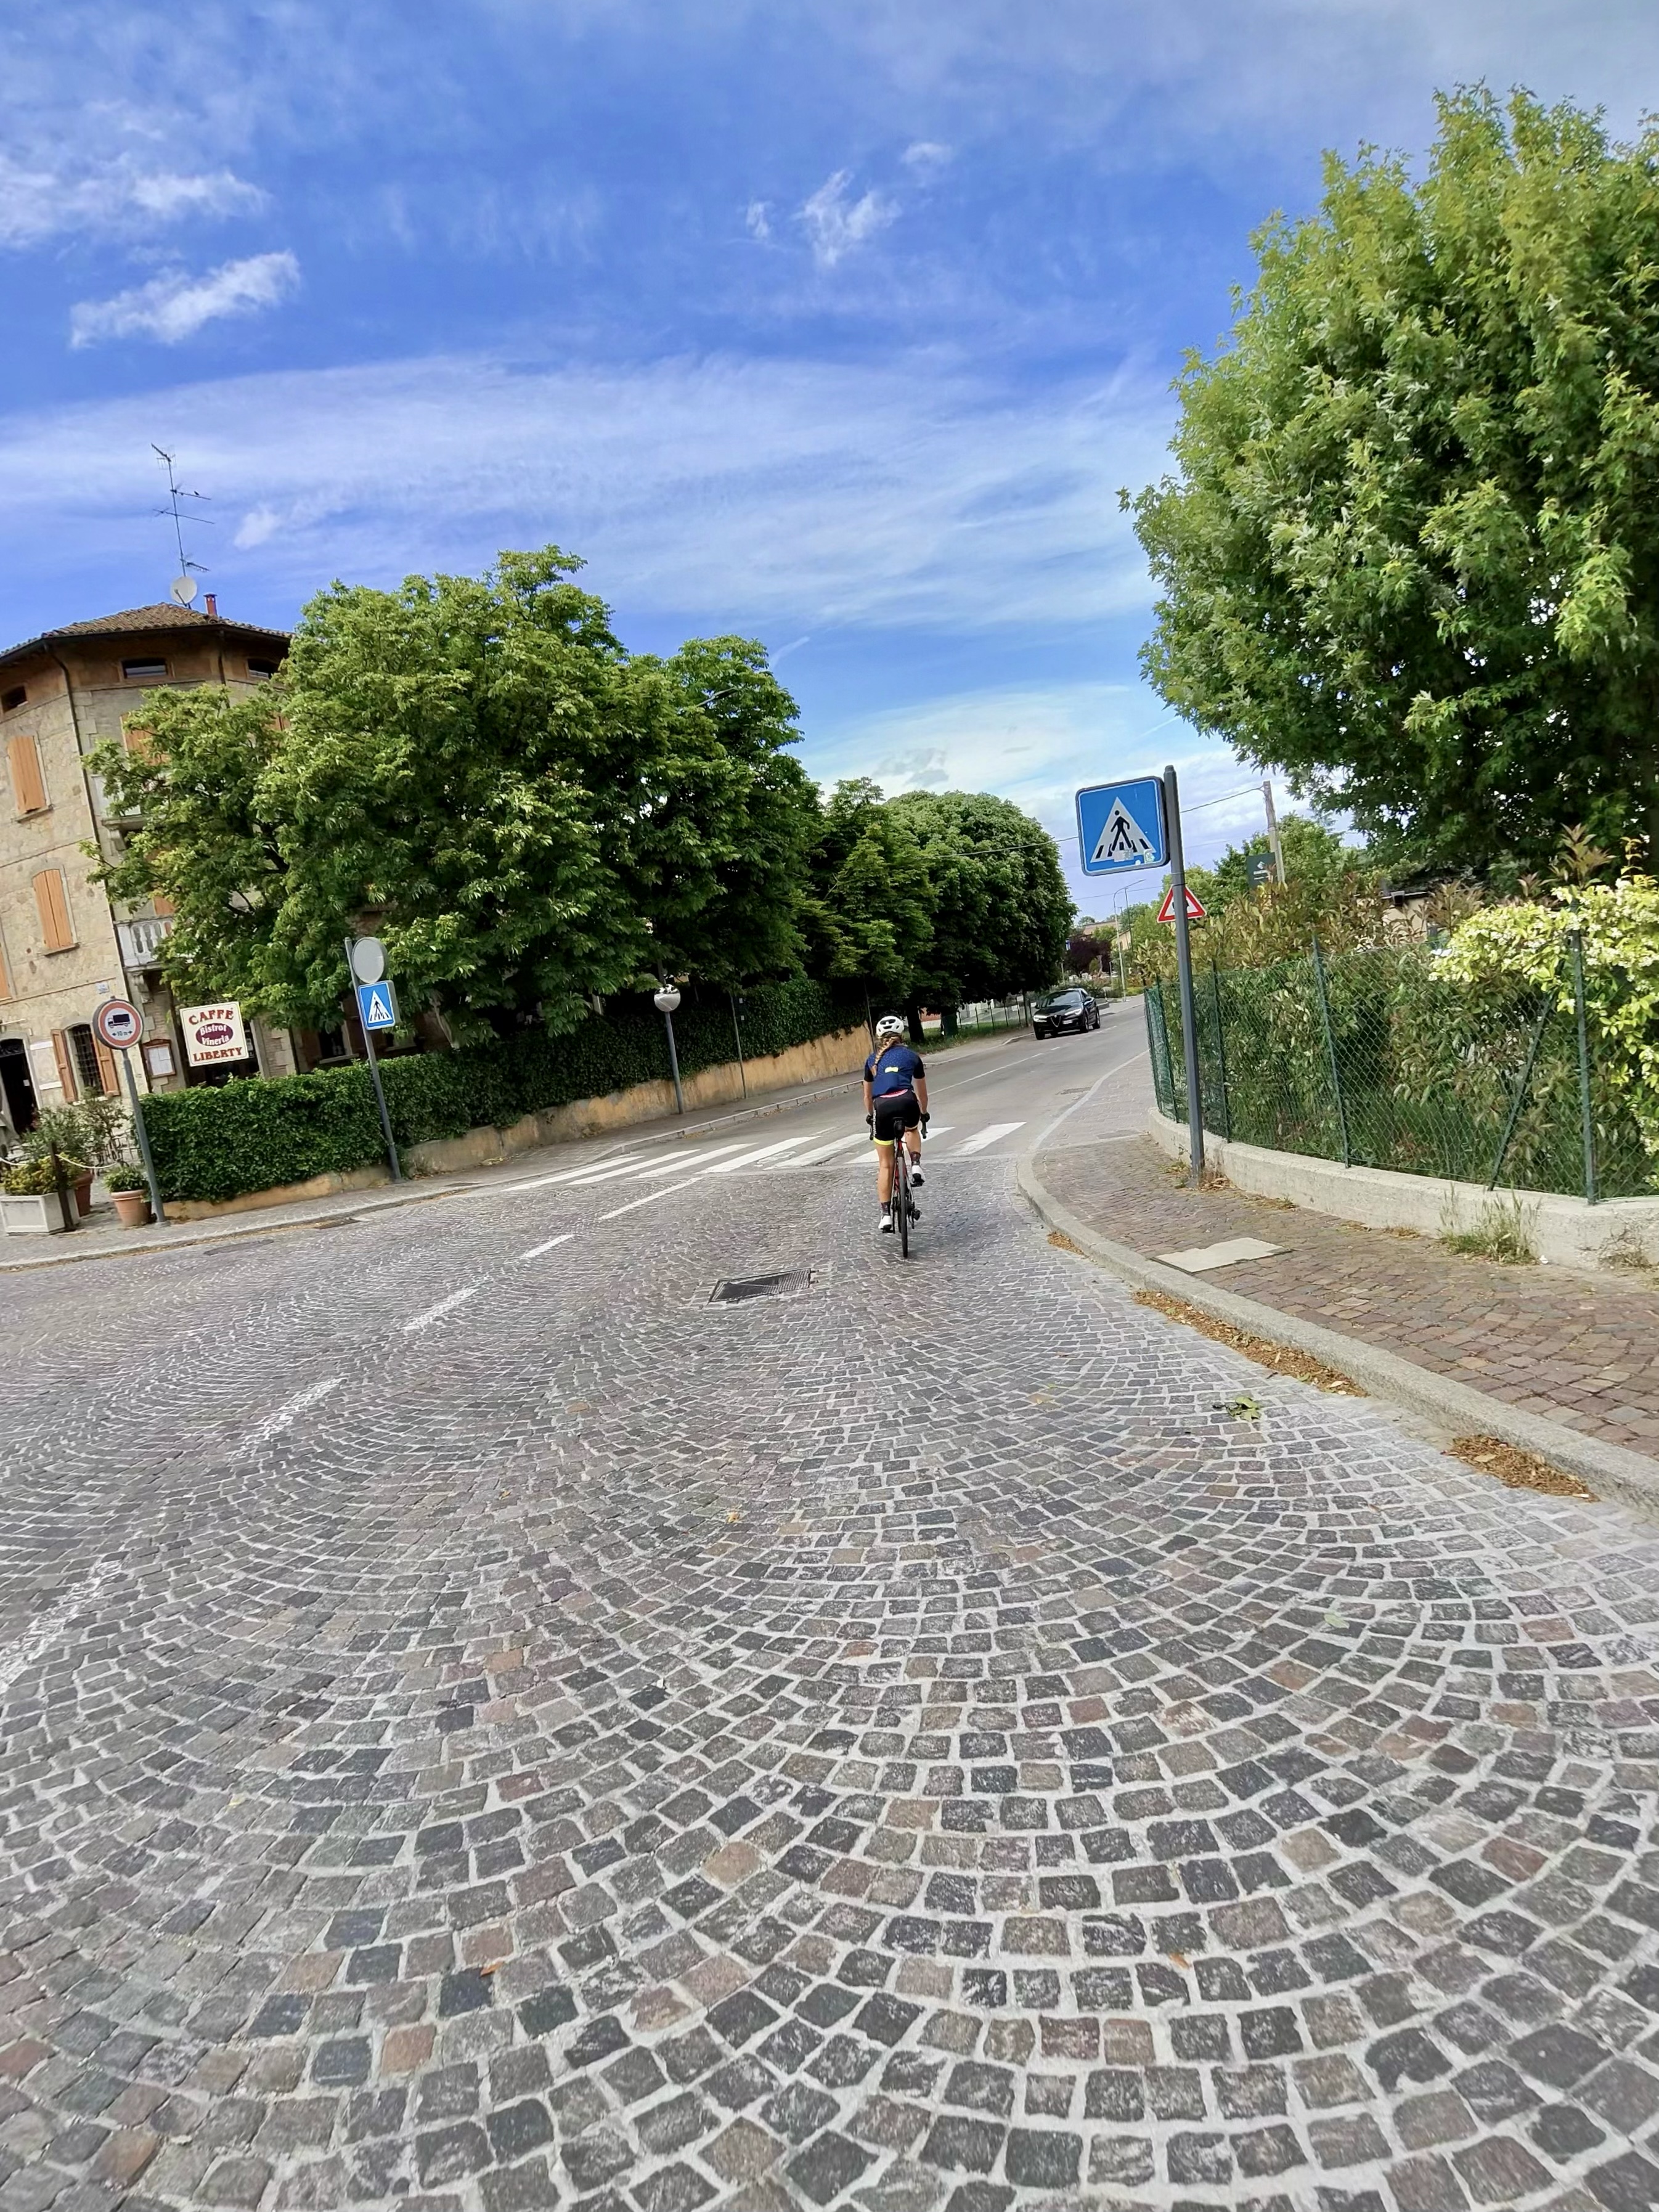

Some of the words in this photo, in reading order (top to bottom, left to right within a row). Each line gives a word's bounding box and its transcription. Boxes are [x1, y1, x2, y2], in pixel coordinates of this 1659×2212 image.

[200, 1024, 227, 1035] Bistrot
[202, 1035, 229, 1045] Vineria
[193, 1047, 242, 1061] LIBERTY
